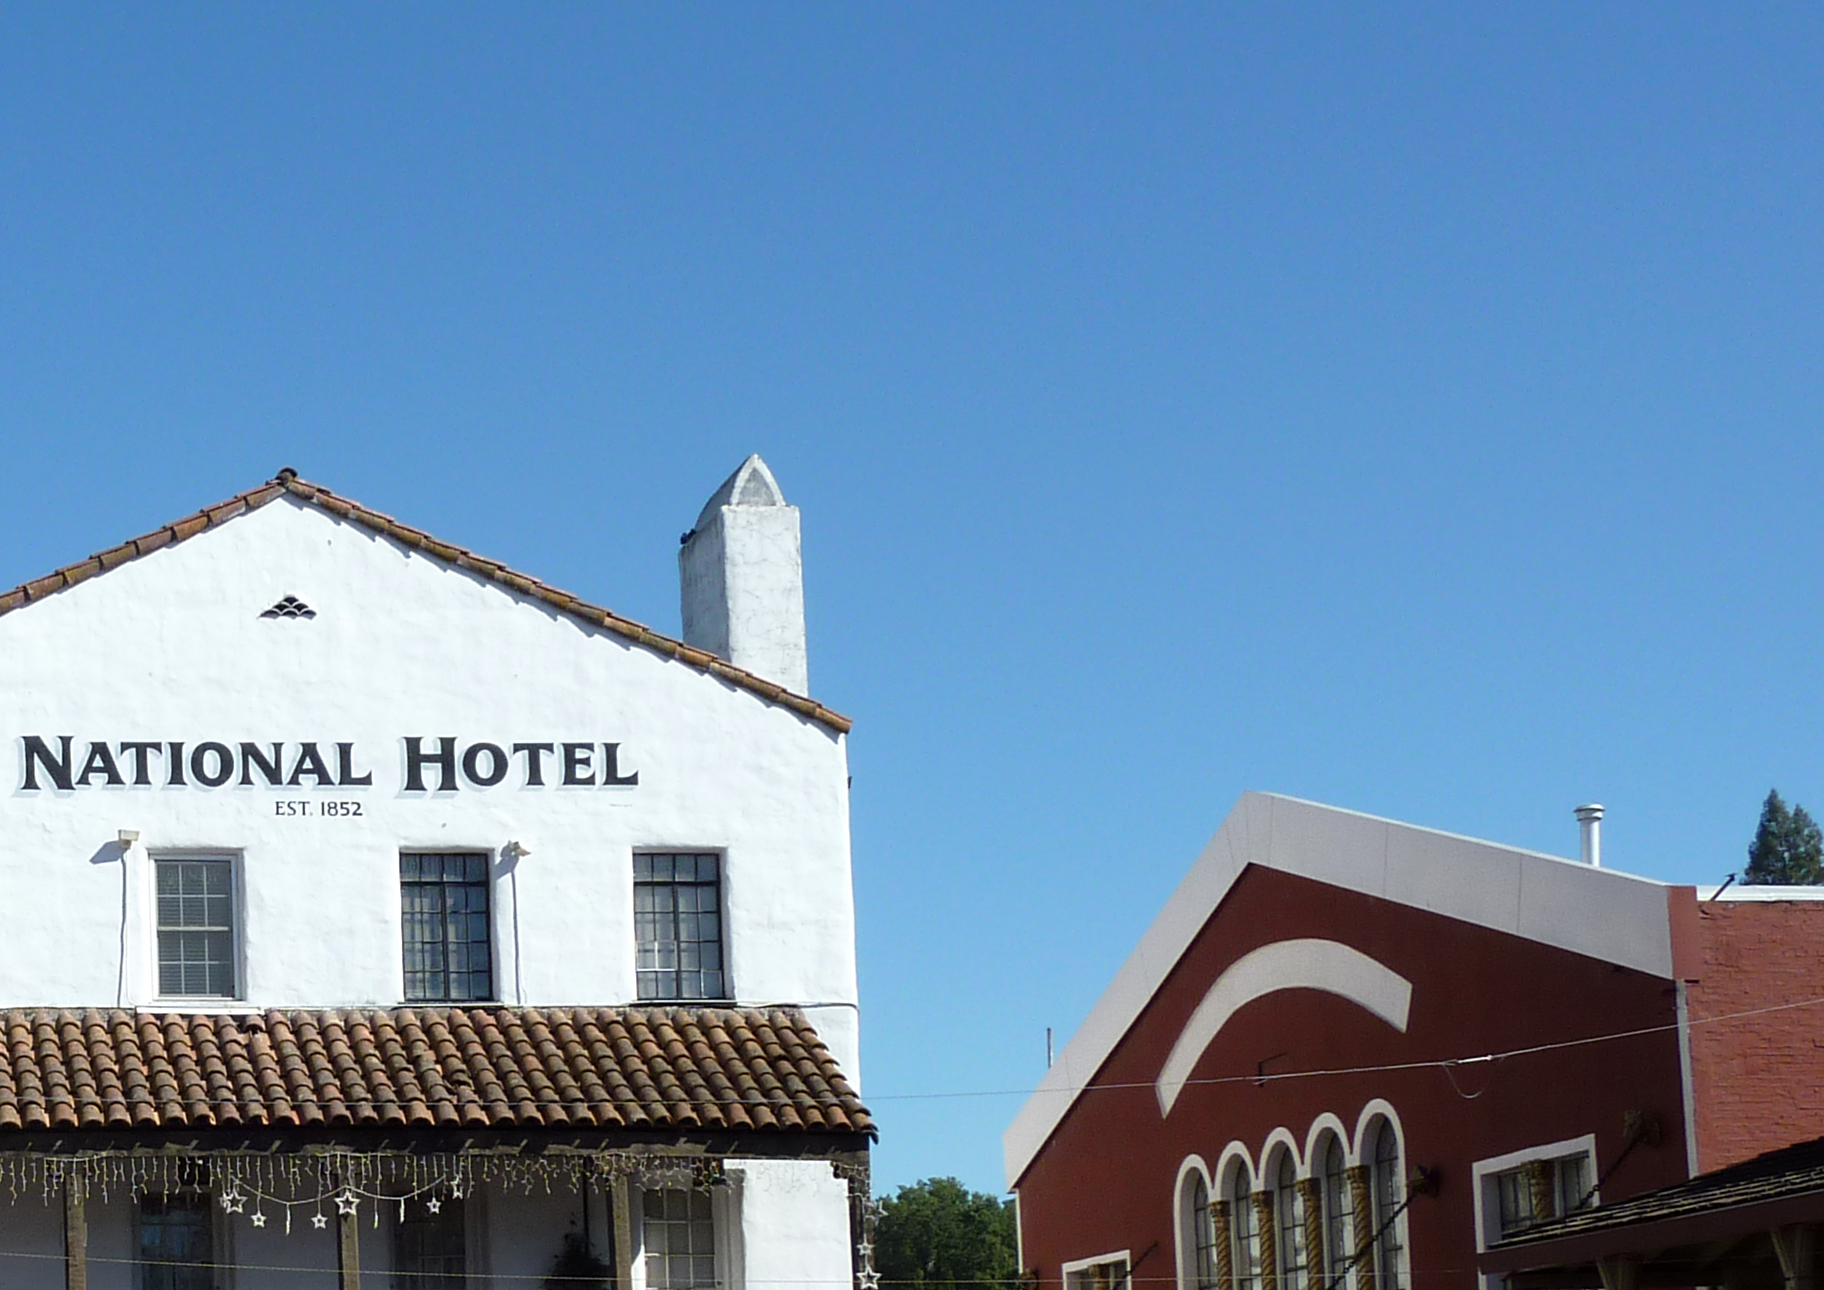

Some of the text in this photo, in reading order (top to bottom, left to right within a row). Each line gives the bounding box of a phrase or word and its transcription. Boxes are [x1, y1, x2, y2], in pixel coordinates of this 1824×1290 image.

[20, 734, 640, 792] NATIONAL HOTEL
[274, 800, 364, 818] EST. 1852
